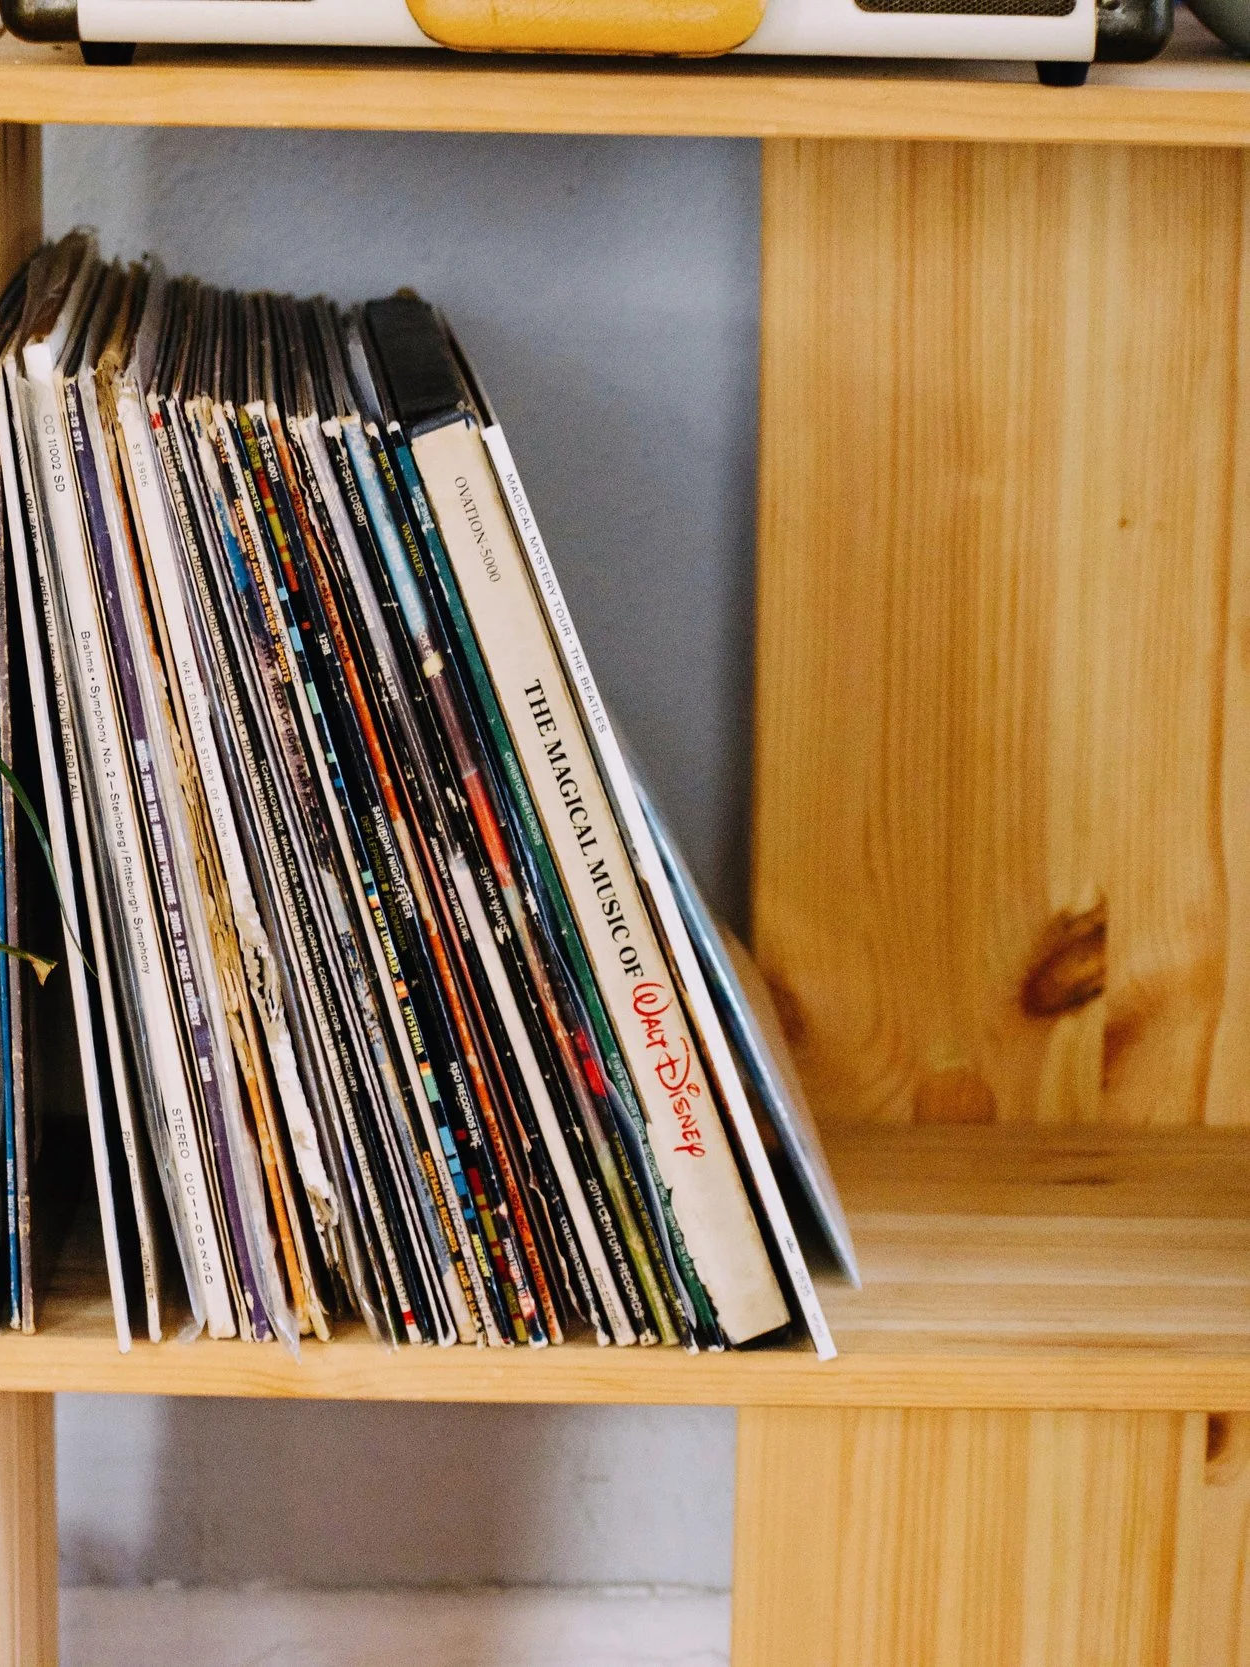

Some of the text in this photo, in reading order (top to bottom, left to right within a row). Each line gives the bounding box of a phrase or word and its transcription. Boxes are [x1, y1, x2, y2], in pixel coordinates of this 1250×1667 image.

[42, 414, 65, 493] CC 11002 SD
[131, 442, 148, 487] ST 3906
[258, 435, 280, 483] RS-2-4001
[173, 487, 184, 498] J.
[177, 500, 187, 512] C.
[233, 498, 247, 529] HUEY
[412, 485, 424, 505] BSK
[181, 513, 195, 546] BACH
[242, 528, 256, 561] LEWIS
[400, 522, 424, 577] VAN HALEN
[454, 475, 501, 583] OVATION-5000
[38, 576, 50, 608] WHEN
[192, 554, 219, 637] HARPSICHORD
[251, 560, 263, 583] AND
[256, 583, 269, 605] THE
[263, 605, 279, 636] NEWS
[506, 473, 608, 734] MAGICAL MYSTERY TOUR THE BEATLES
[273, 641, 292, 683] SPORTS
[316, 632, 332, 656] 1298
[413, 618, 431, 649] LOOK
[424, 649, 441, 679] BK
[216, 639, 237, 702] CONCERTO
[374, 650, 400, 701] THRILLER
[232, 704, 242, 716] IN
[236, 718, 245, 726] A
[269, 676, 285, 710] PIECES
[284, 727, 299, 757] EIGHT
[62, 732, 74, 769] HEARD
[181, 659, 194, 687] WALT
[189, 693, 205, 742] DISNEY'S
[201, 747, 214, 783] STORY
[209, 788, 219, 801] OF
[214, 807, 228, 838] SNOW
[242, 738, 258, 778] HAYDN
[67, 770, 76, 781] IT
[69, 783, 80, 803] ALL
[502, 750, 544, 846] CHRISTOPHER CROSS
[81, 630, 150, 975] Brahms Symphony No. 2 Steinberg Pittsburgh Symphony
[255, 787, 282, 869] HARPSICHORD
[524, 679, 557, 737] THE
[544, 739, 598, 857] MAGICAL
[586, 858, 630, 943] MUSIC
[618, 945, 645, 980] OF
[135, 738, 201, 1027] MUSIC FROM THE MOTION PICTURE 2001: A SPACE ODYSSEY
[359, 814, 409, 952] DEF LEPPARD PYROMANIA
[369, 804, 414, 919] SATURDAY NIGHT FEVER
[279, 871, 301, 934] CONCERTO
[446, 887, 470, 943] DEPARTURE
[479, 866, 508, 933] STAR WARS
[257, 758, 286, 831] TCHAIKOVSKY
[295, 887, 309, 921] ANTAL
[315, 966, 342, 1032] CONDUCTOR
[337, 1041, 359, 1093] MERCURY
[305, 968, 327, 1026] OVERTURE
[371, 909, 424, 1055] DEF LEPPARD HYSTERIA
[196, 1056, 213, 1083] MGM
[325, 1042, 335, 1051] D
[448, 1060, 463, 1084] RSO
[345, 1107, 362, 1151] STEREO
[455, 1082, 477, 1130] RECORDS
[171, 1107, 190, 1159] STEREO
[611, 1059, 624, 1079] 1979
[619, 1079, 636, 1116] WARNER
[664, 1205, 682, 1244] PRINTED
[421, 1150, 445, 1206] CHRYSALIS
[438, 1205, 459, 1253] RECORDS
[469, 1232, 492, 1279] MERCURY
[502, 1237, 522, 1277] PRINTED
[513, 1276, 525, 1290] IN
[586, 1176, 605, 1207] 20TH
[596, 1206, 625, 1261] CENTURY
[615, 1261, 645, 1319] RECORDS
[455, 1260, 469, 1288] MADE
